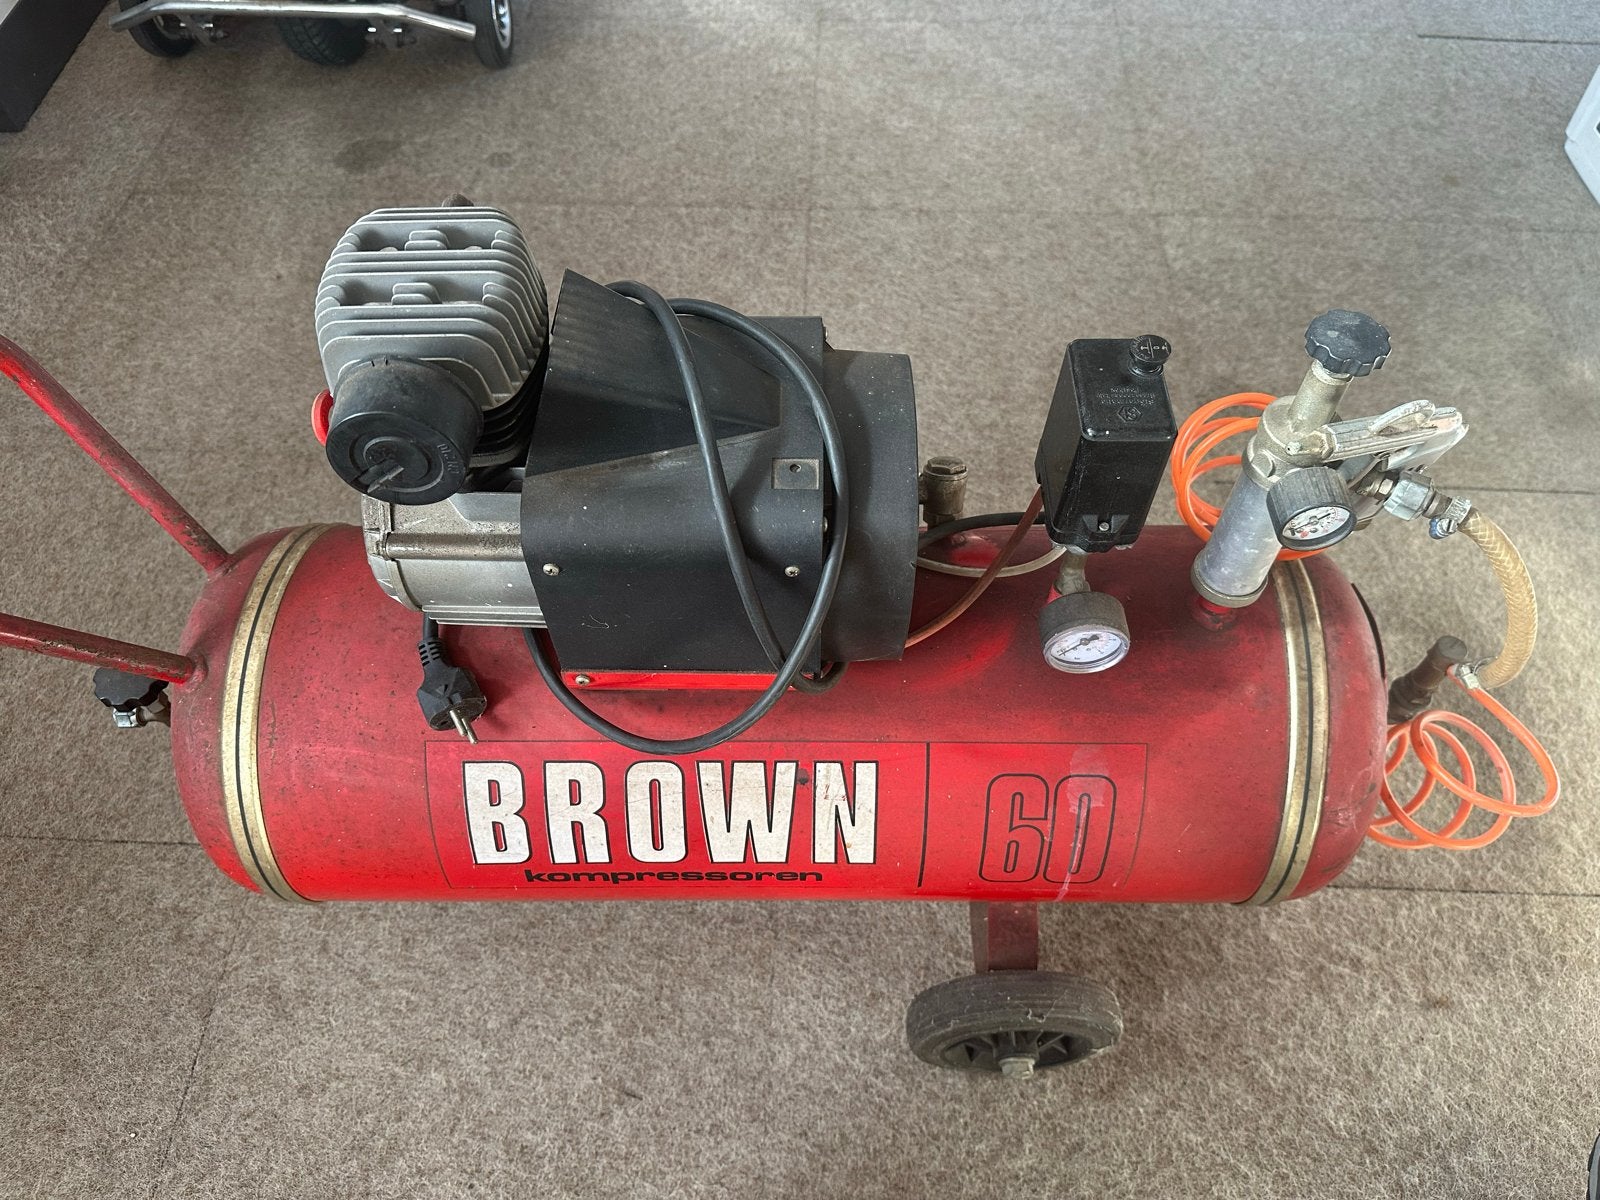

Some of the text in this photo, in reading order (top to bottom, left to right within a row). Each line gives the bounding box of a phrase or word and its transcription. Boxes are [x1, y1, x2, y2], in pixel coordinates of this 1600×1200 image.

[462, 759, 880, 865] BROWN
[978, 773, 1117, 884] 60
[524, 869, 823, 885] kompressoren
